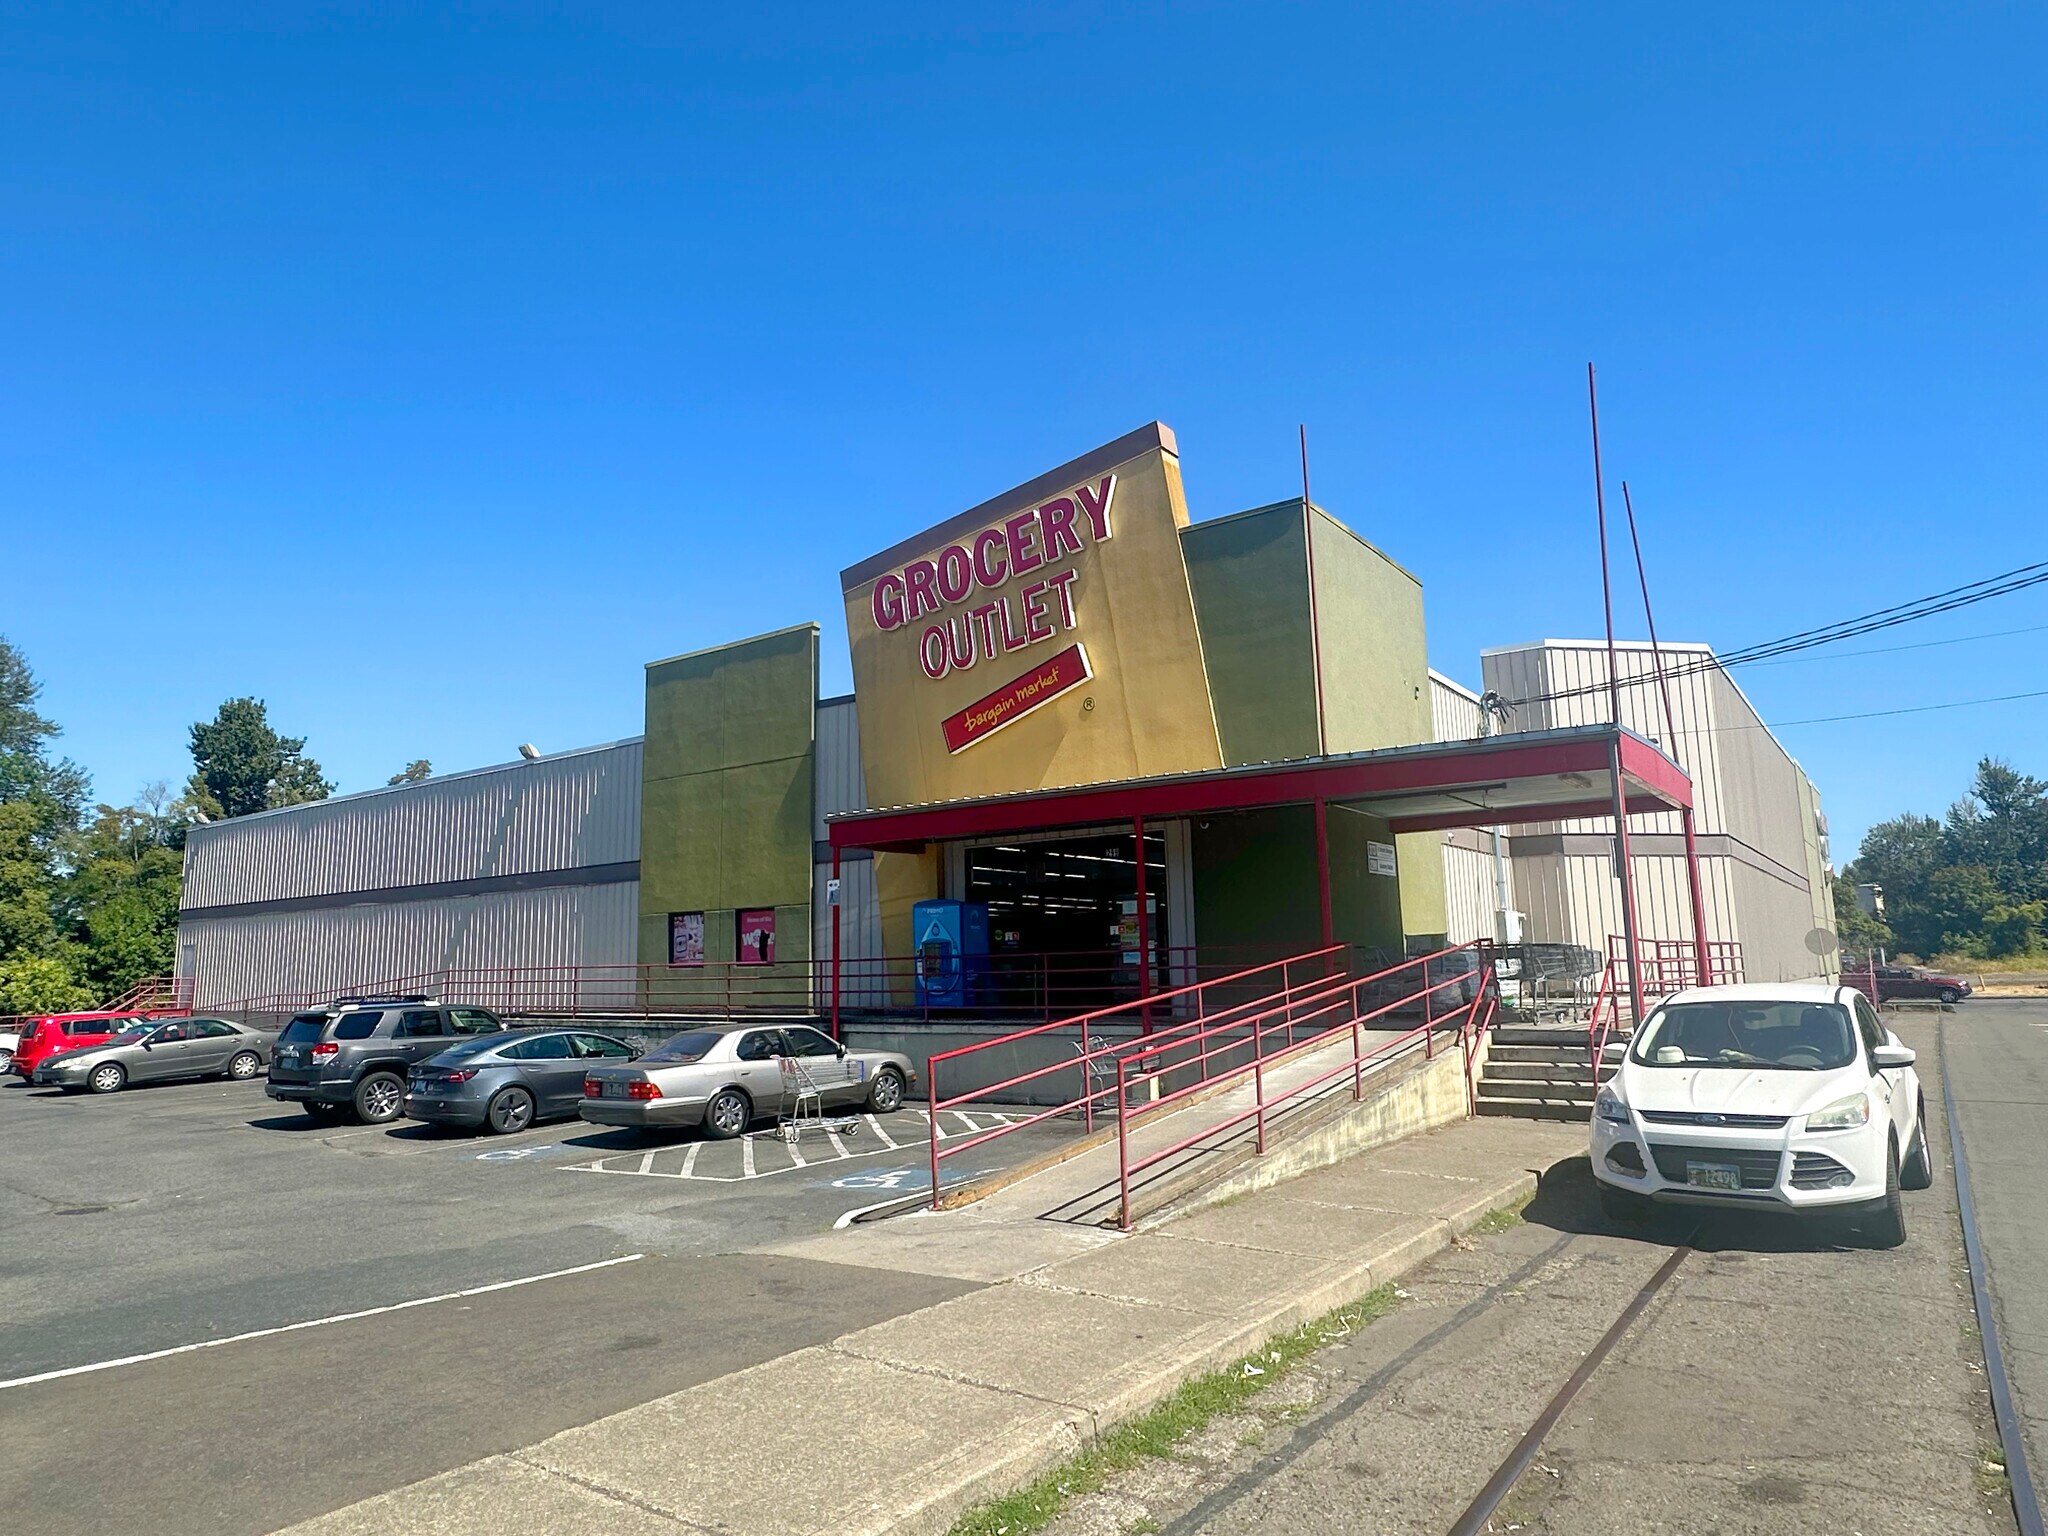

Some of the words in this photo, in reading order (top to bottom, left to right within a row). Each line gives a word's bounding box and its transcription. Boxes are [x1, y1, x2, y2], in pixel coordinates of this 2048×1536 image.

[872, 474, 1117, 631] GROCERY
[920, 568, 1079, 679] OUTLET
[964, 698, 1016, 732] bargain
[1015, 667, 1059, 702] market
